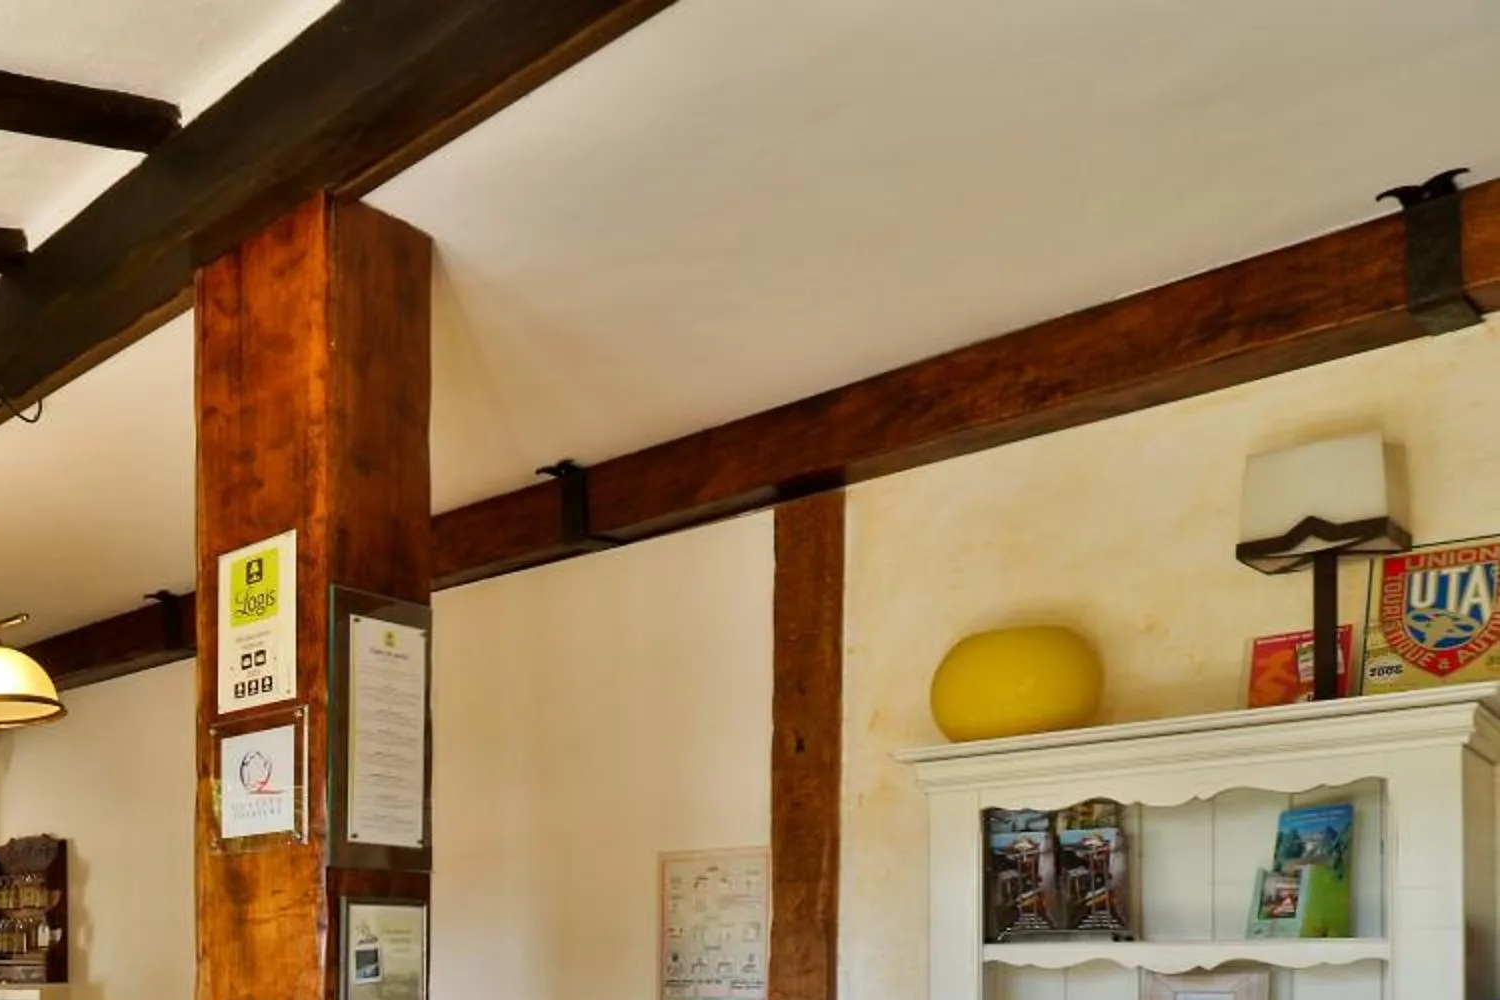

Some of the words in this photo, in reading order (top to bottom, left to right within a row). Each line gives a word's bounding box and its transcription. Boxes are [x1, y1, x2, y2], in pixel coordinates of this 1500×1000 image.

[1405, 544, 1499, 571] UNION
[232, 587, 277, 618] Logis
[1410, 564, 1491, 624] UTA
